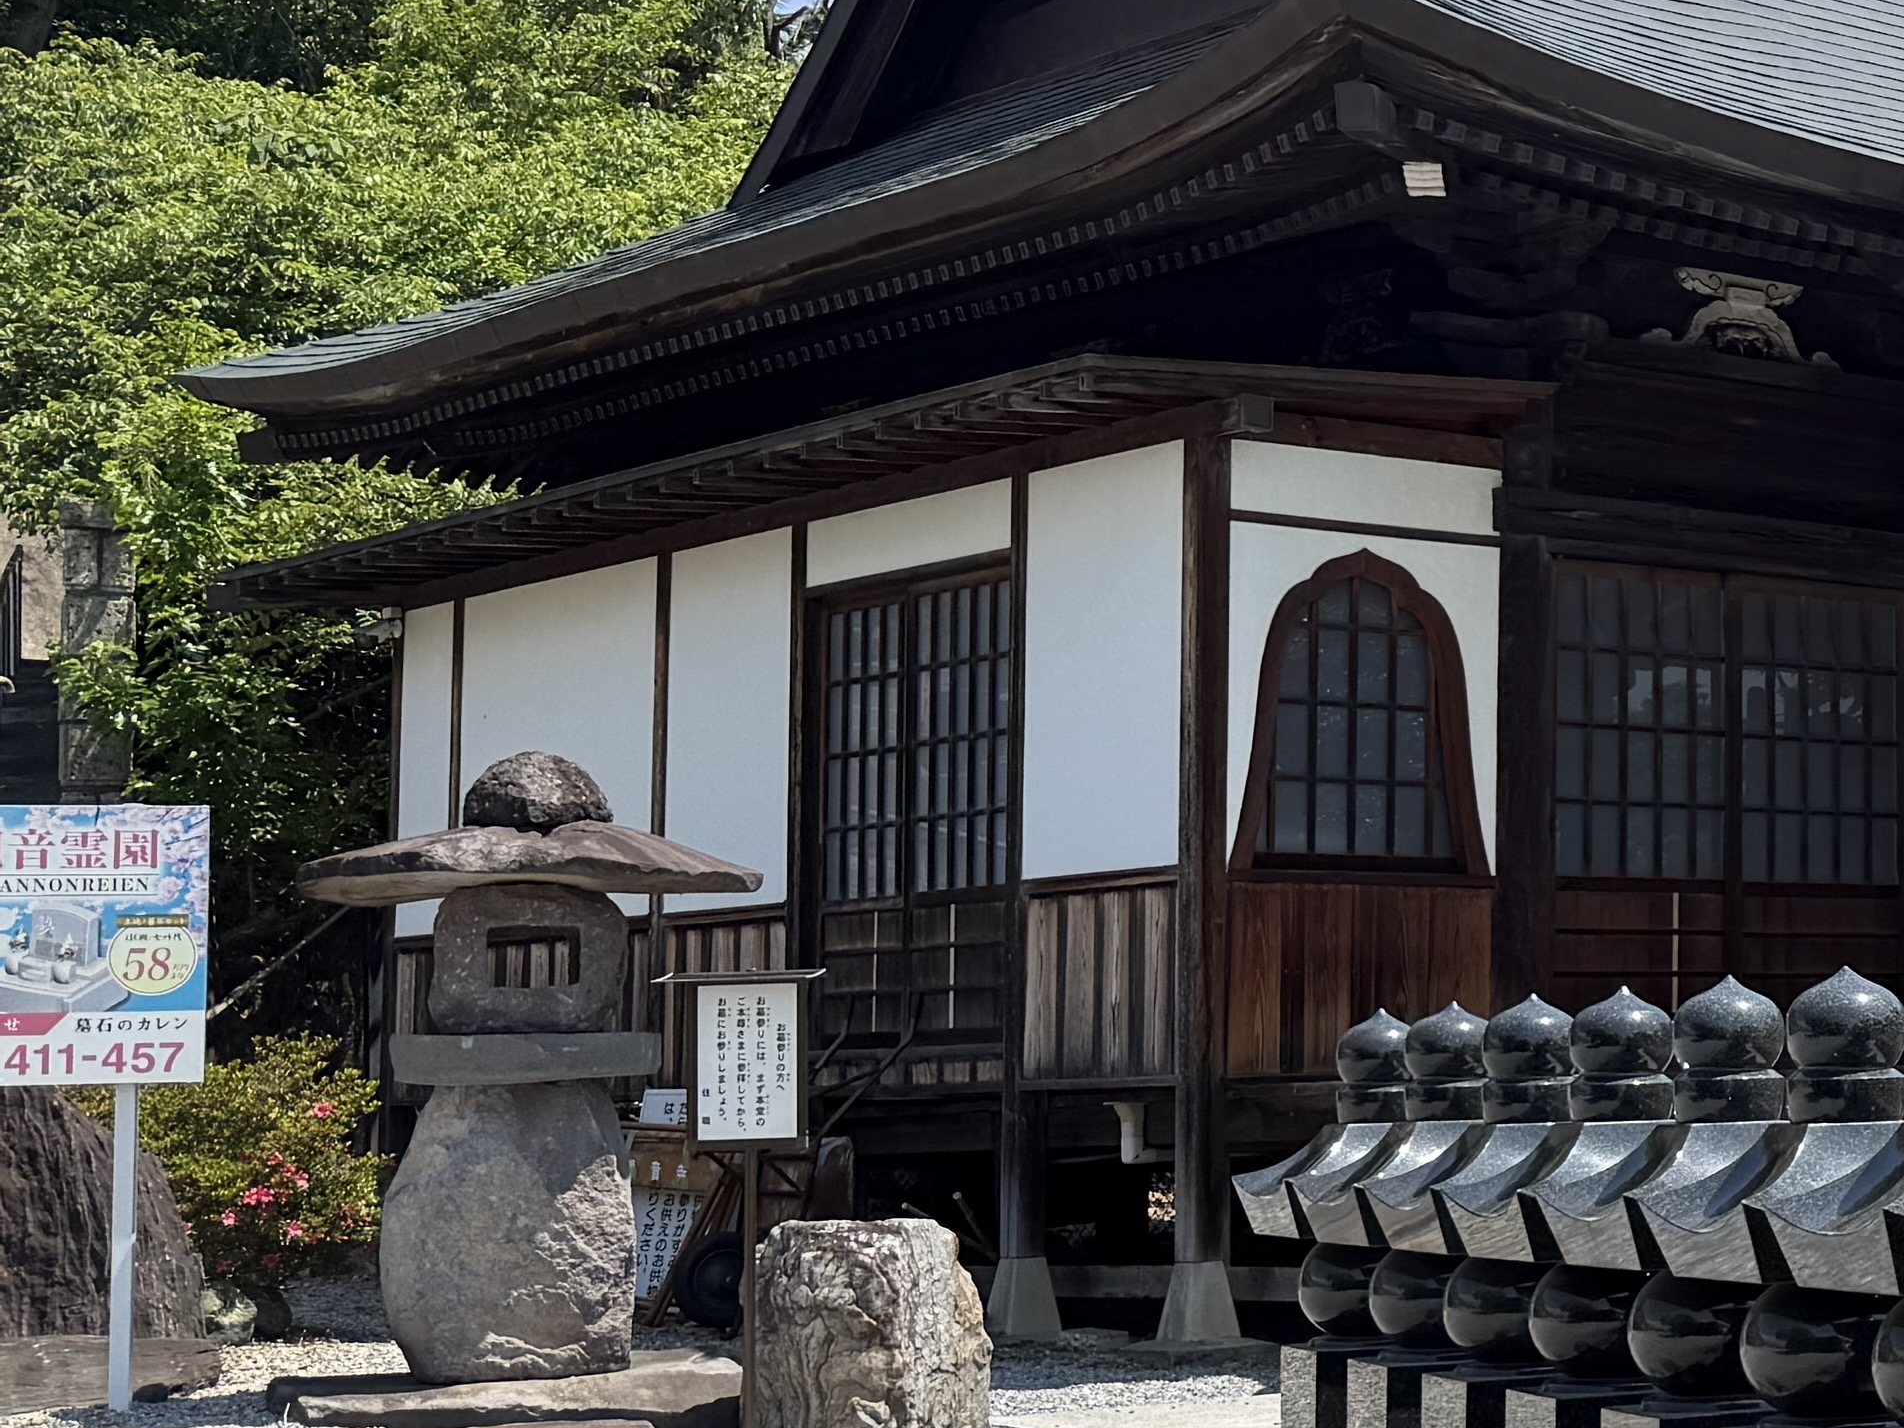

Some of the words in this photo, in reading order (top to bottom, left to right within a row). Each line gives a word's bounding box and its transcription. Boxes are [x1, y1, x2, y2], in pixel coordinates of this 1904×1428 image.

[0, 828, 159, 870] 音霊園
[122, 947, 171, 981] 58
[75, 1017, 188, 1033] 墓石のカレン
[4, 1042, 185, 1076] 411-457
